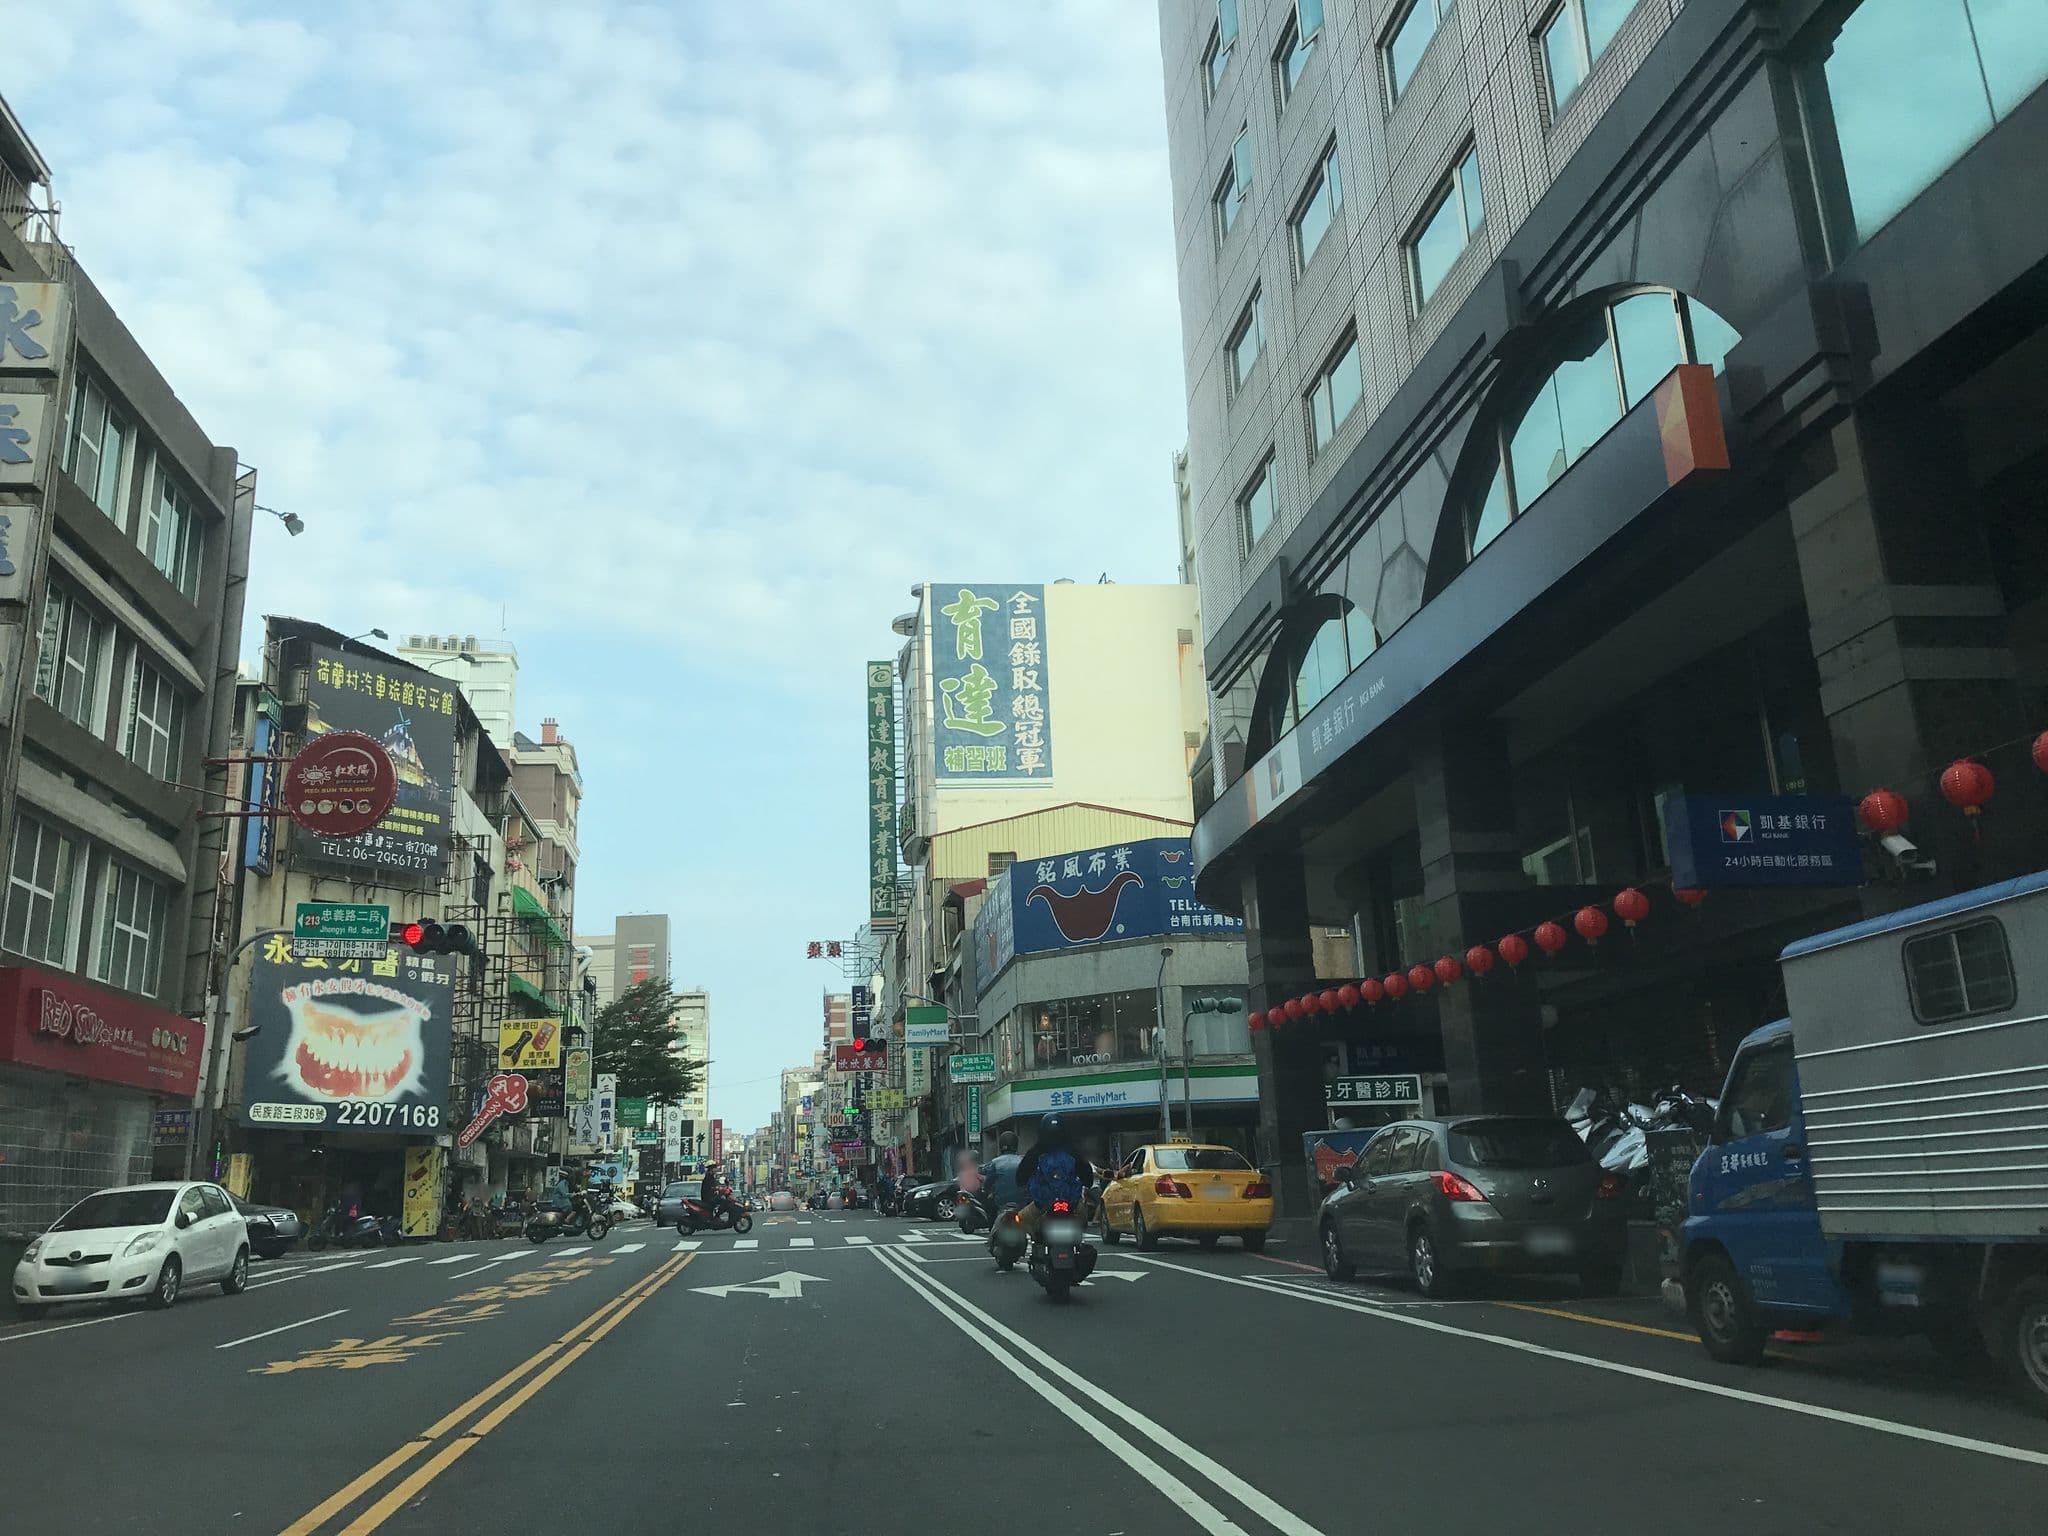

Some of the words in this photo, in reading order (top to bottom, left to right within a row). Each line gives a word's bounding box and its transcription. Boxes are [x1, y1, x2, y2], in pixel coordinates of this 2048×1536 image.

[939, 588, 1007, 737] 育達
[1007, 590, 1046, 776] 全國錄取總冠軍
[944, 745, 1007, 772] 補習班
[1759, 814, 1827, 831] 凱基銀行
[1035, 848, 1133, 883] 銘風布業
[305, 915, 321, 926] 213
[321, 908, 380, 922] 忠義路二段
[907, 1028, 948, 1039] FamilyMart
[1050, 1090, 1075, 1107] 全家
[1077, 1090, 1128, 1105] FamilyMart
[251, 1104, 325, 1121] 民族路三段36號
[336, 1101, 440, 1128] 2207168
